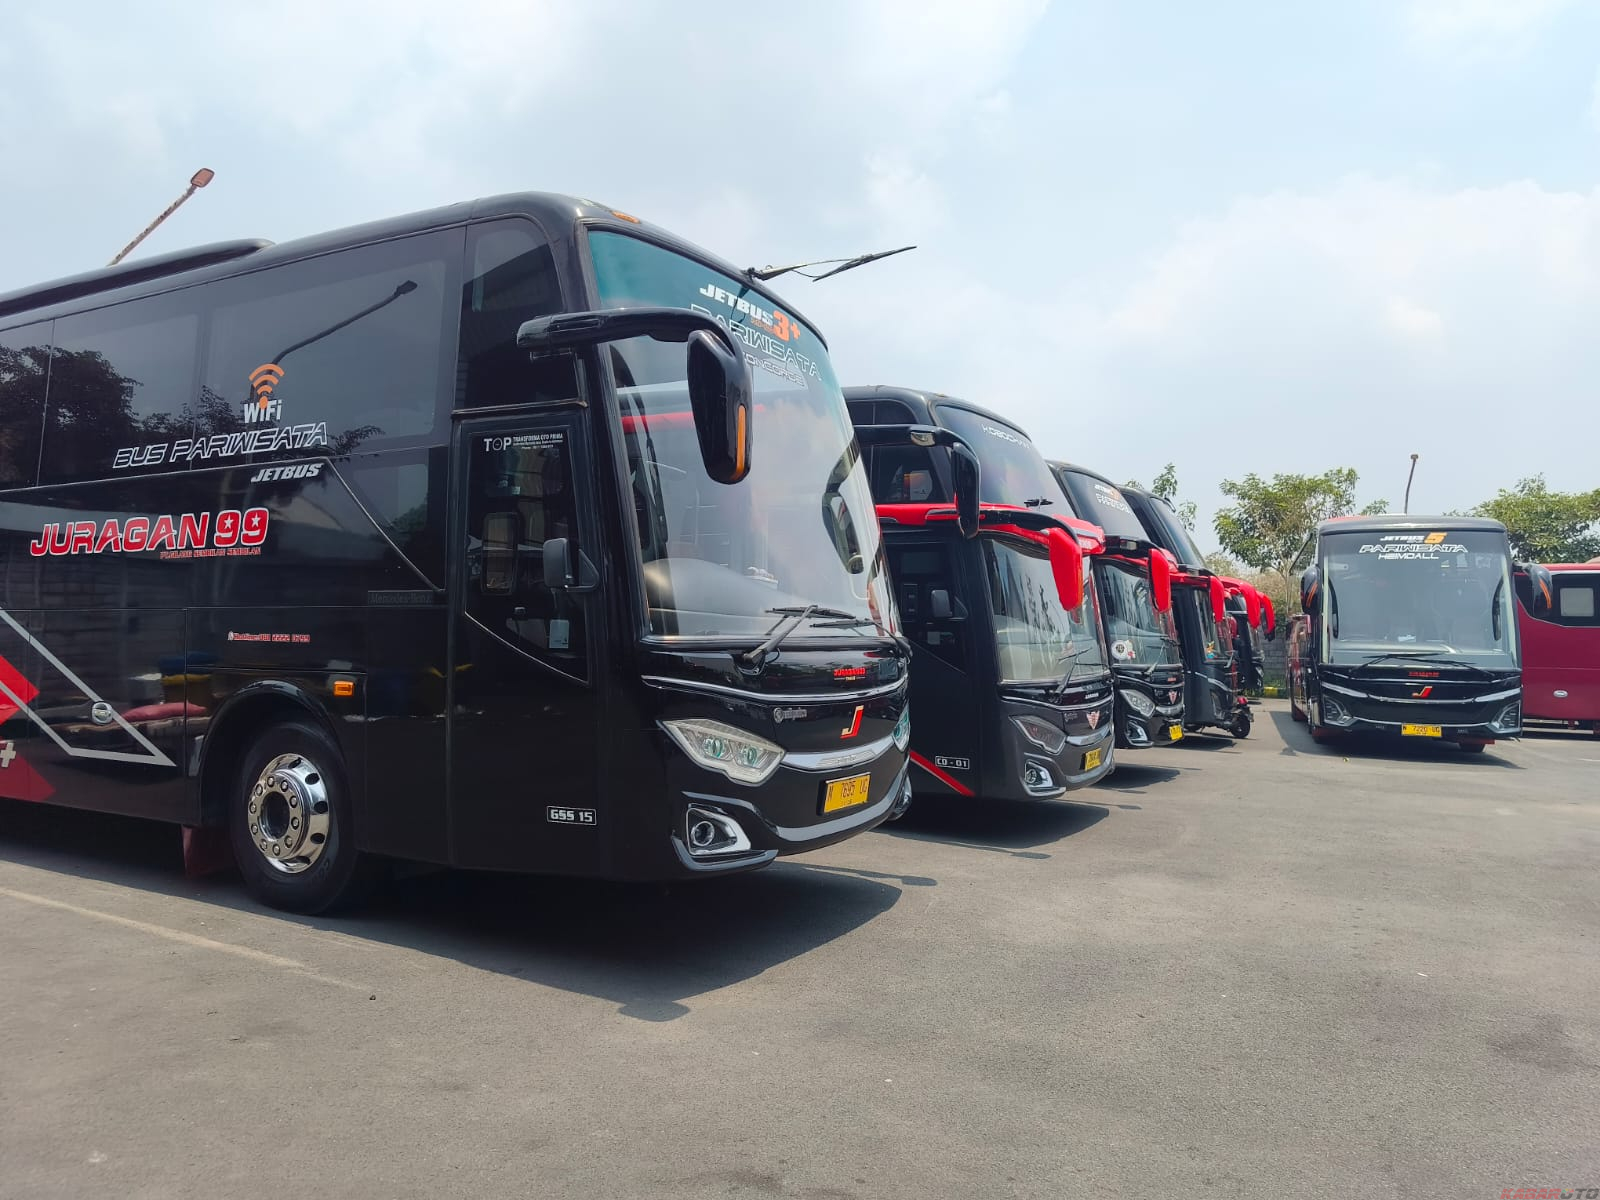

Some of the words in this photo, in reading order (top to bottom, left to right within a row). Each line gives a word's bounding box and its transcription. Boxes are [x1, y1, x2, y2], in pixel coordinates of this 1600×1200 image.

[113, 443, 169, 469] BUS
[169, 421, 328, 463] PARIWISATA
[484, 437, 512, 452] TOP
[250, 463, 324, 483] JETBUS
[30, 512, 210, 557] JURAGAN
[213, 507, 270, 548] 99
[1359, 544, 1468, 553] PARIWISATA
[578, 811, 593, 822] 15
